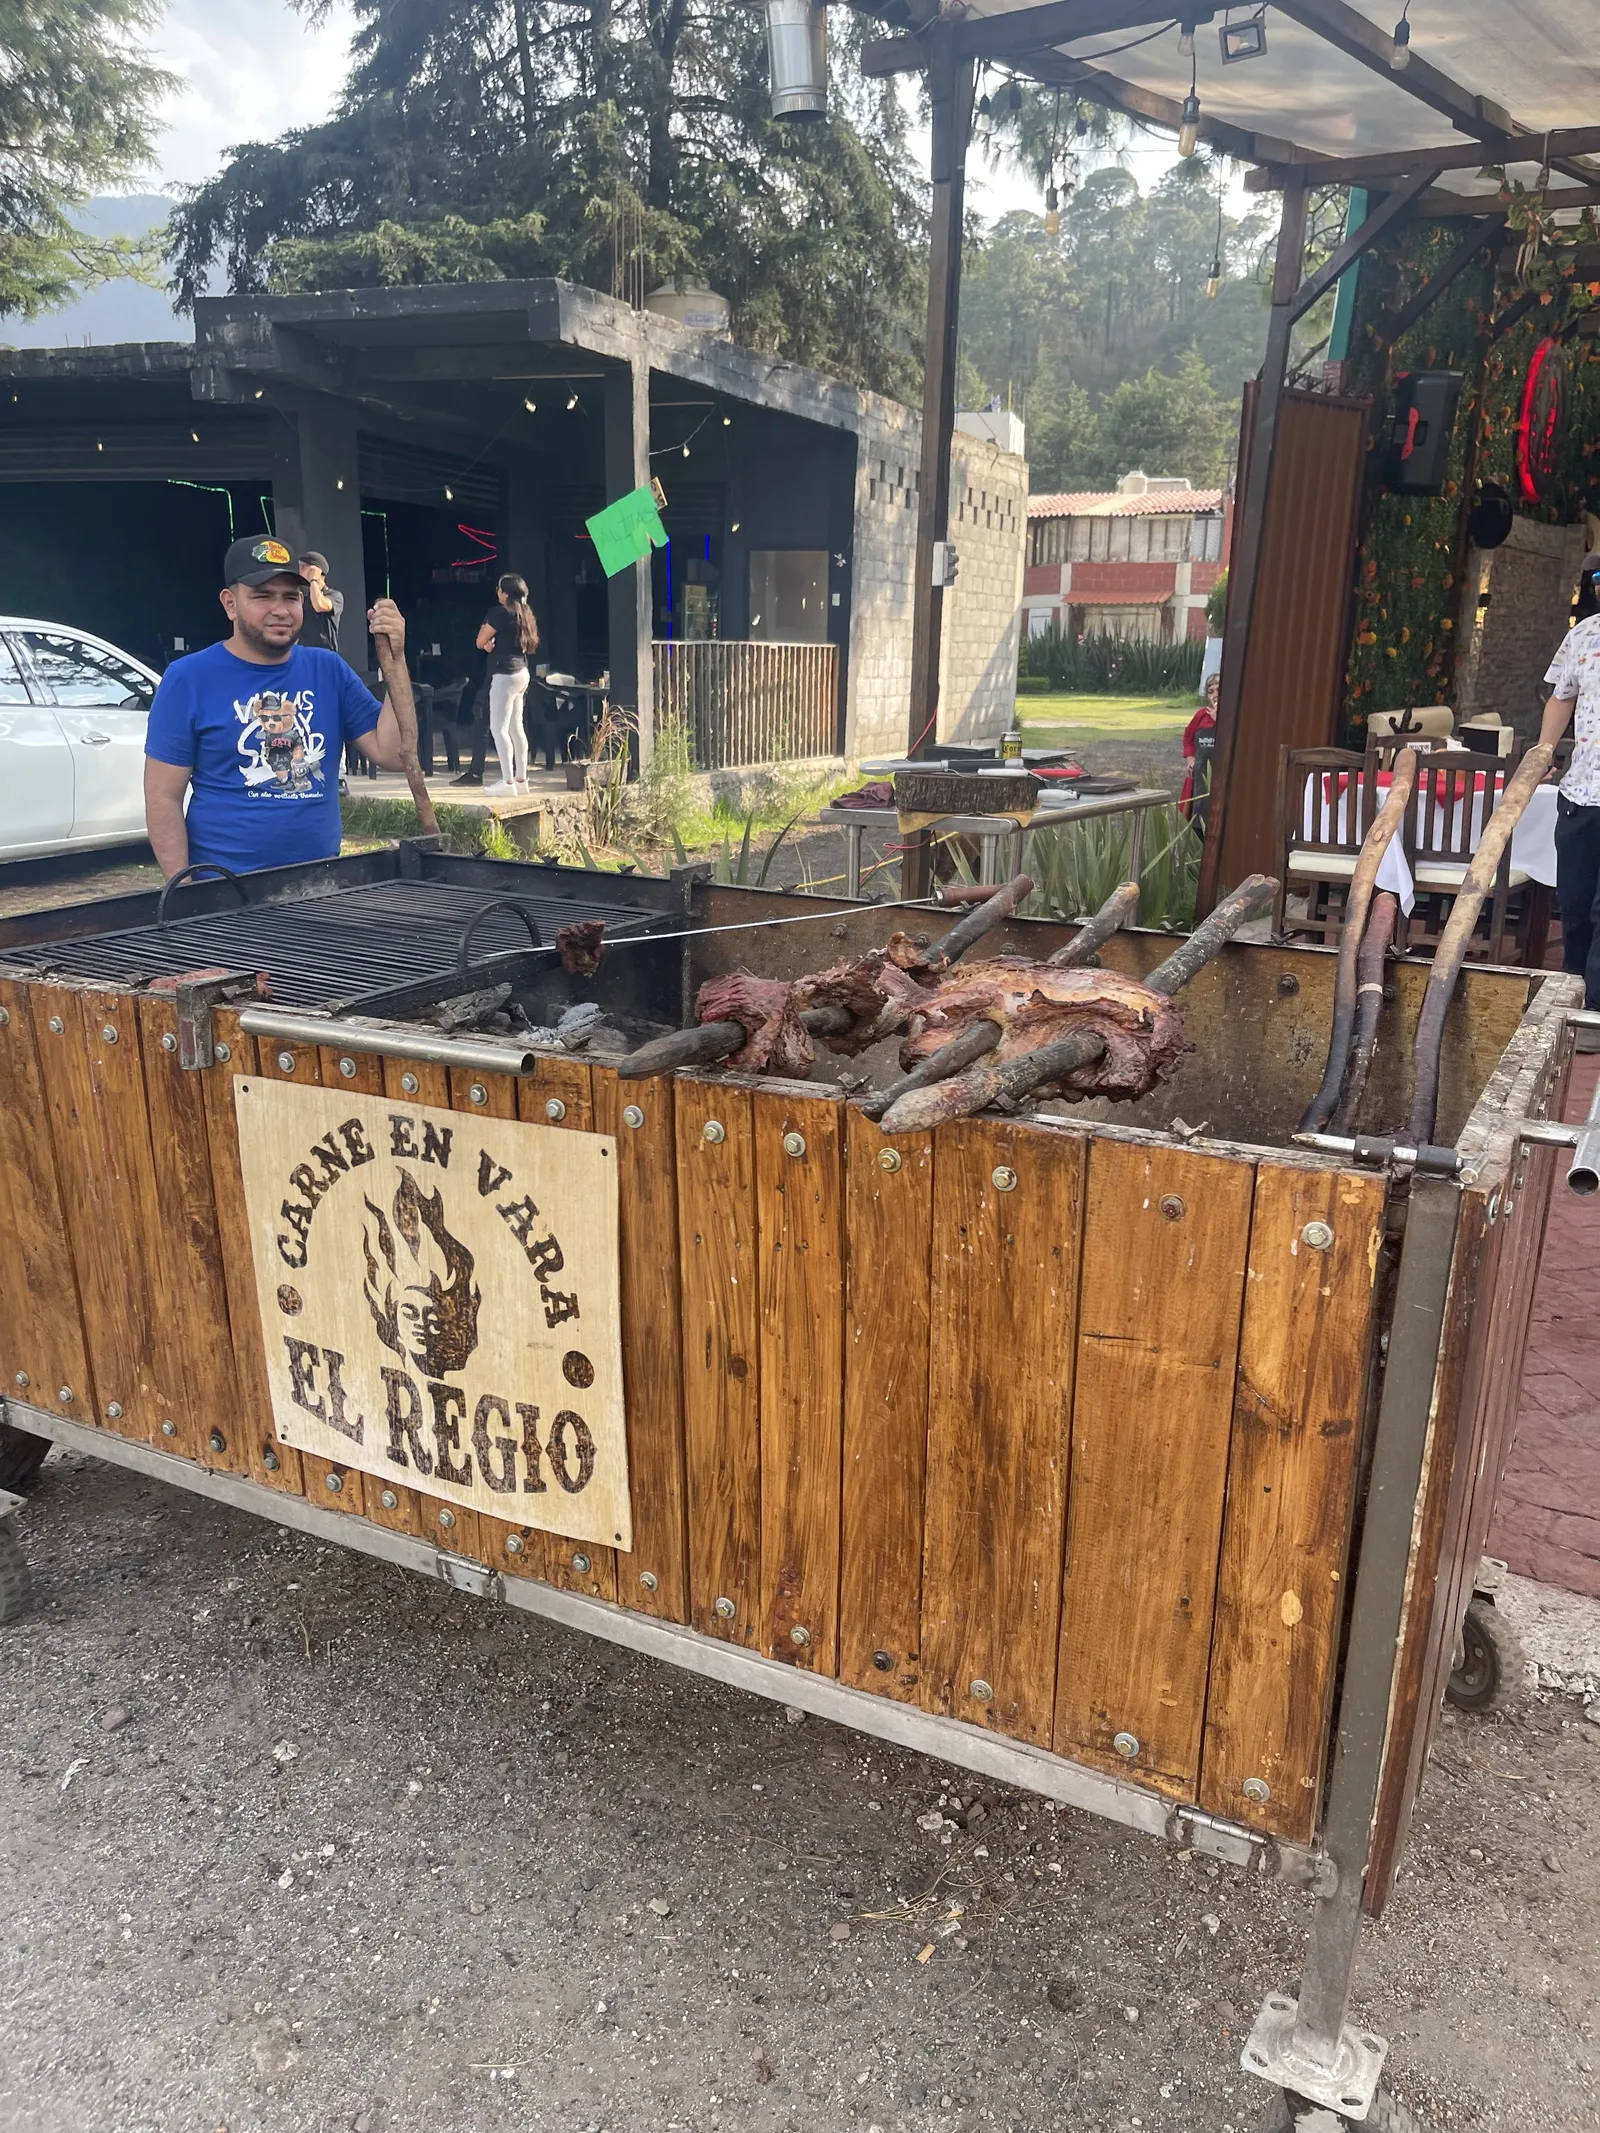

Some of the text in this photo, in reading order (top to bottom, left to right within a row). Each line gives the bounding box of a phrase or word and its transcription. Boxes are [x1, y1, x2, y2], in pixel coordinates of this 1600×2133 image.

[278, 1114, 580, 1329] CARNE EN VARA
[284, 1336, 597, 1494] EL REGIO
